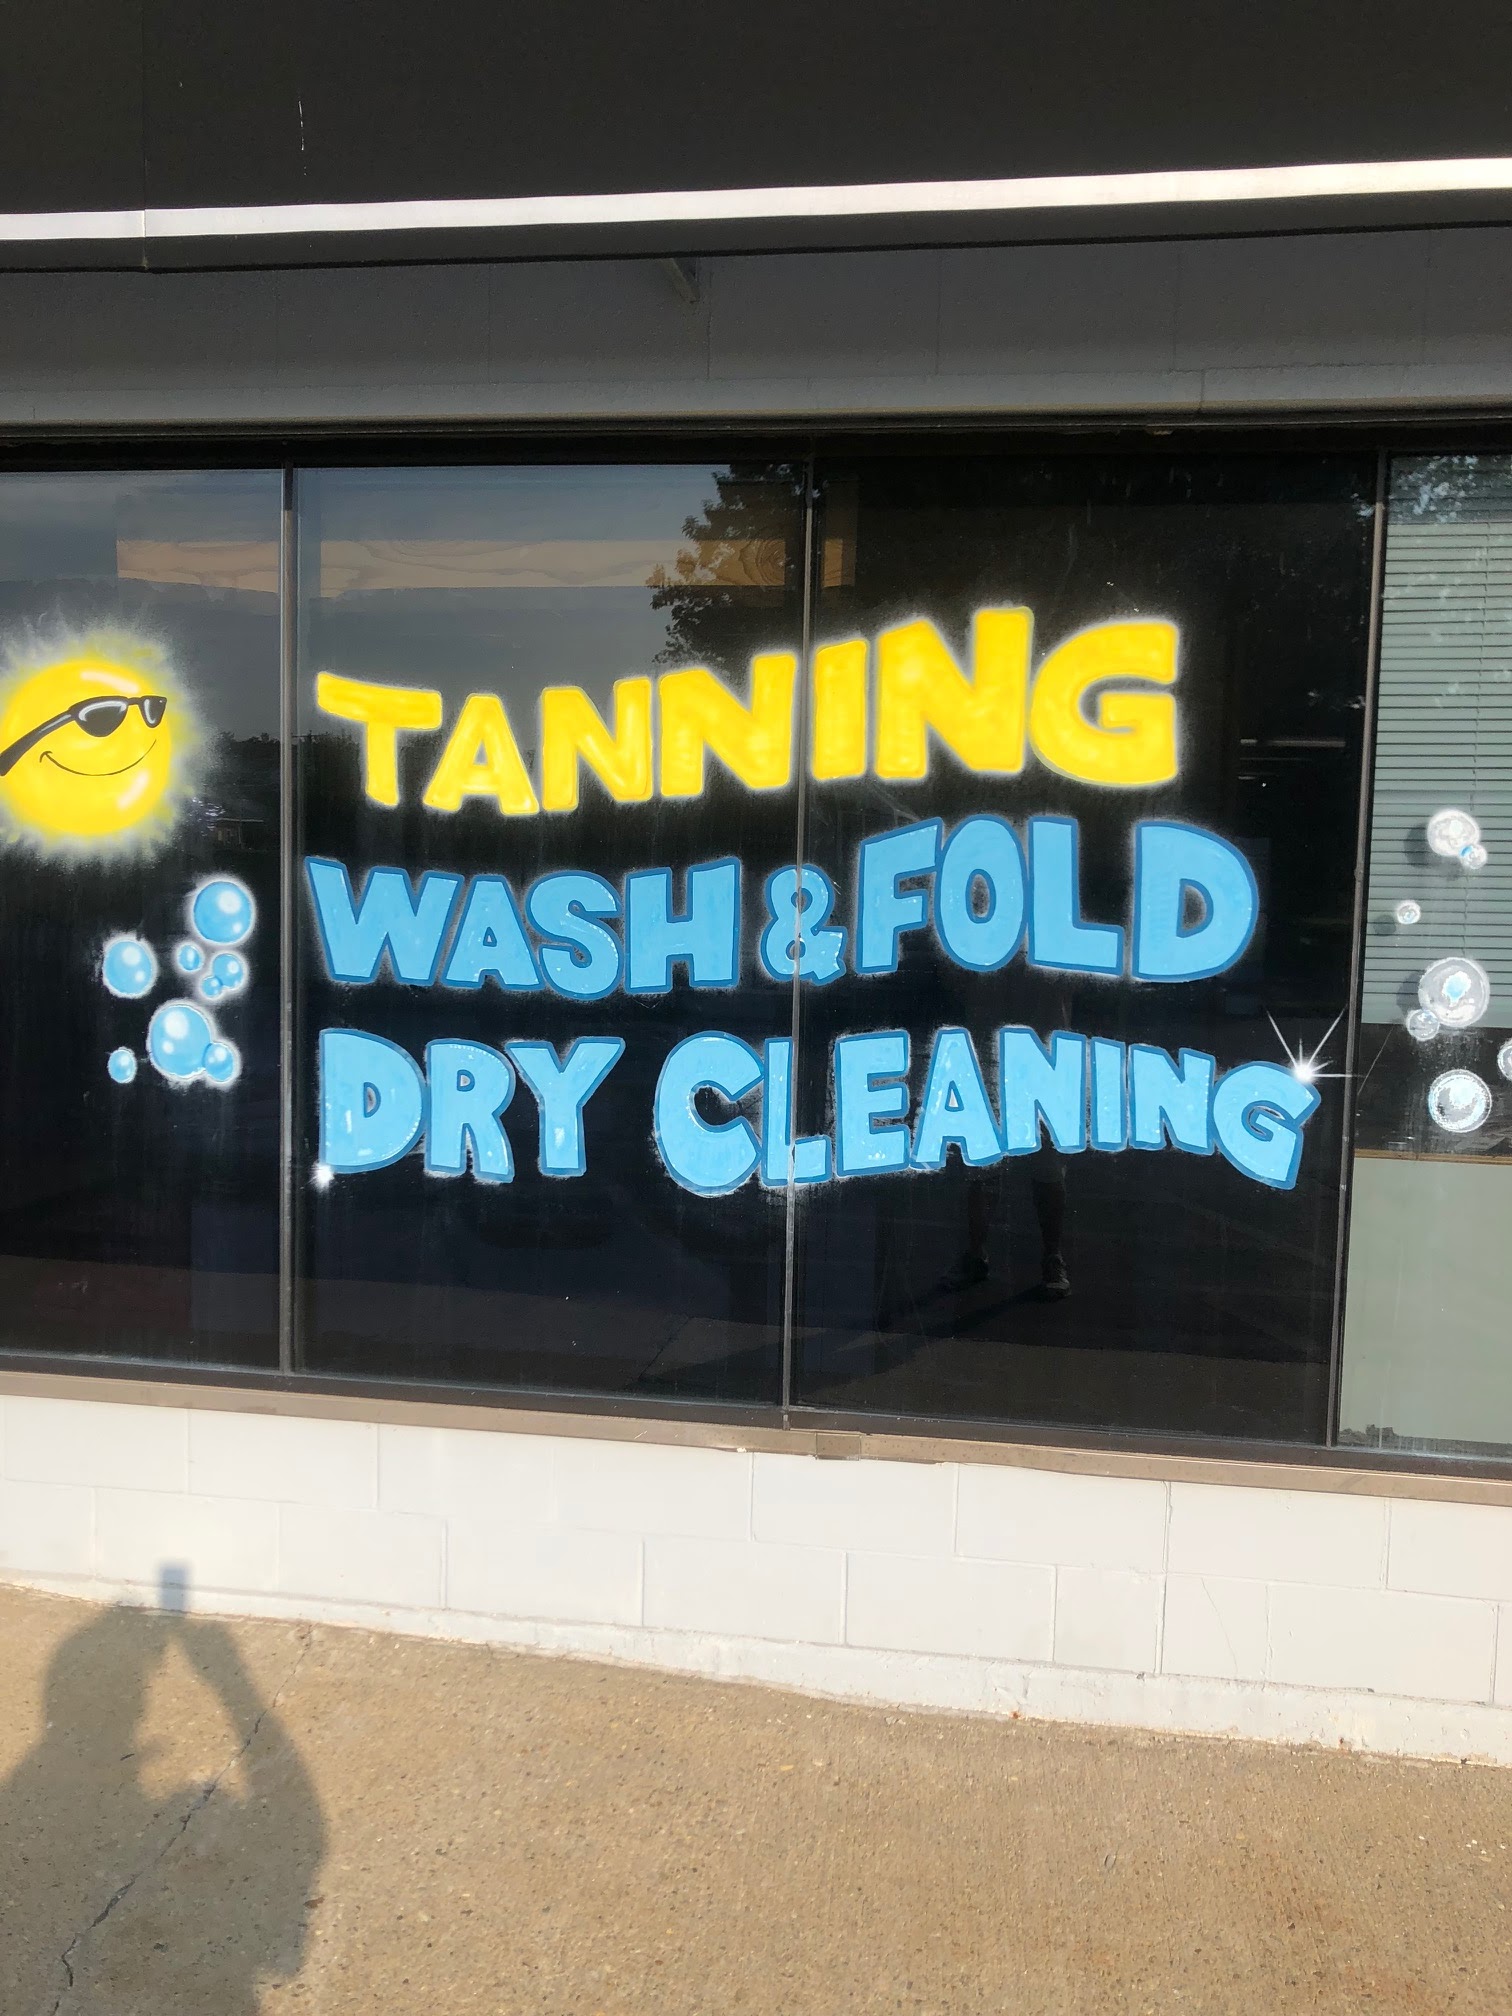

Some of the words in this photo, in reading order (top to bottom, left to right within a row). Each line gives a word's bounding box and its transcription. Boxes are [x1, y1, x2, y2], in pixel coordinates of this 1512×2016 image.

[315, 606, 1180, 815] TANNING
[305, 857, 741, 1000] WASH
[760, 864, 848, 986] &
[856, 814, 1260, 983] FOLD
[319, 1028, 626, 1183] DRY
[654, 1025, 1322, 1197] CLEANING
